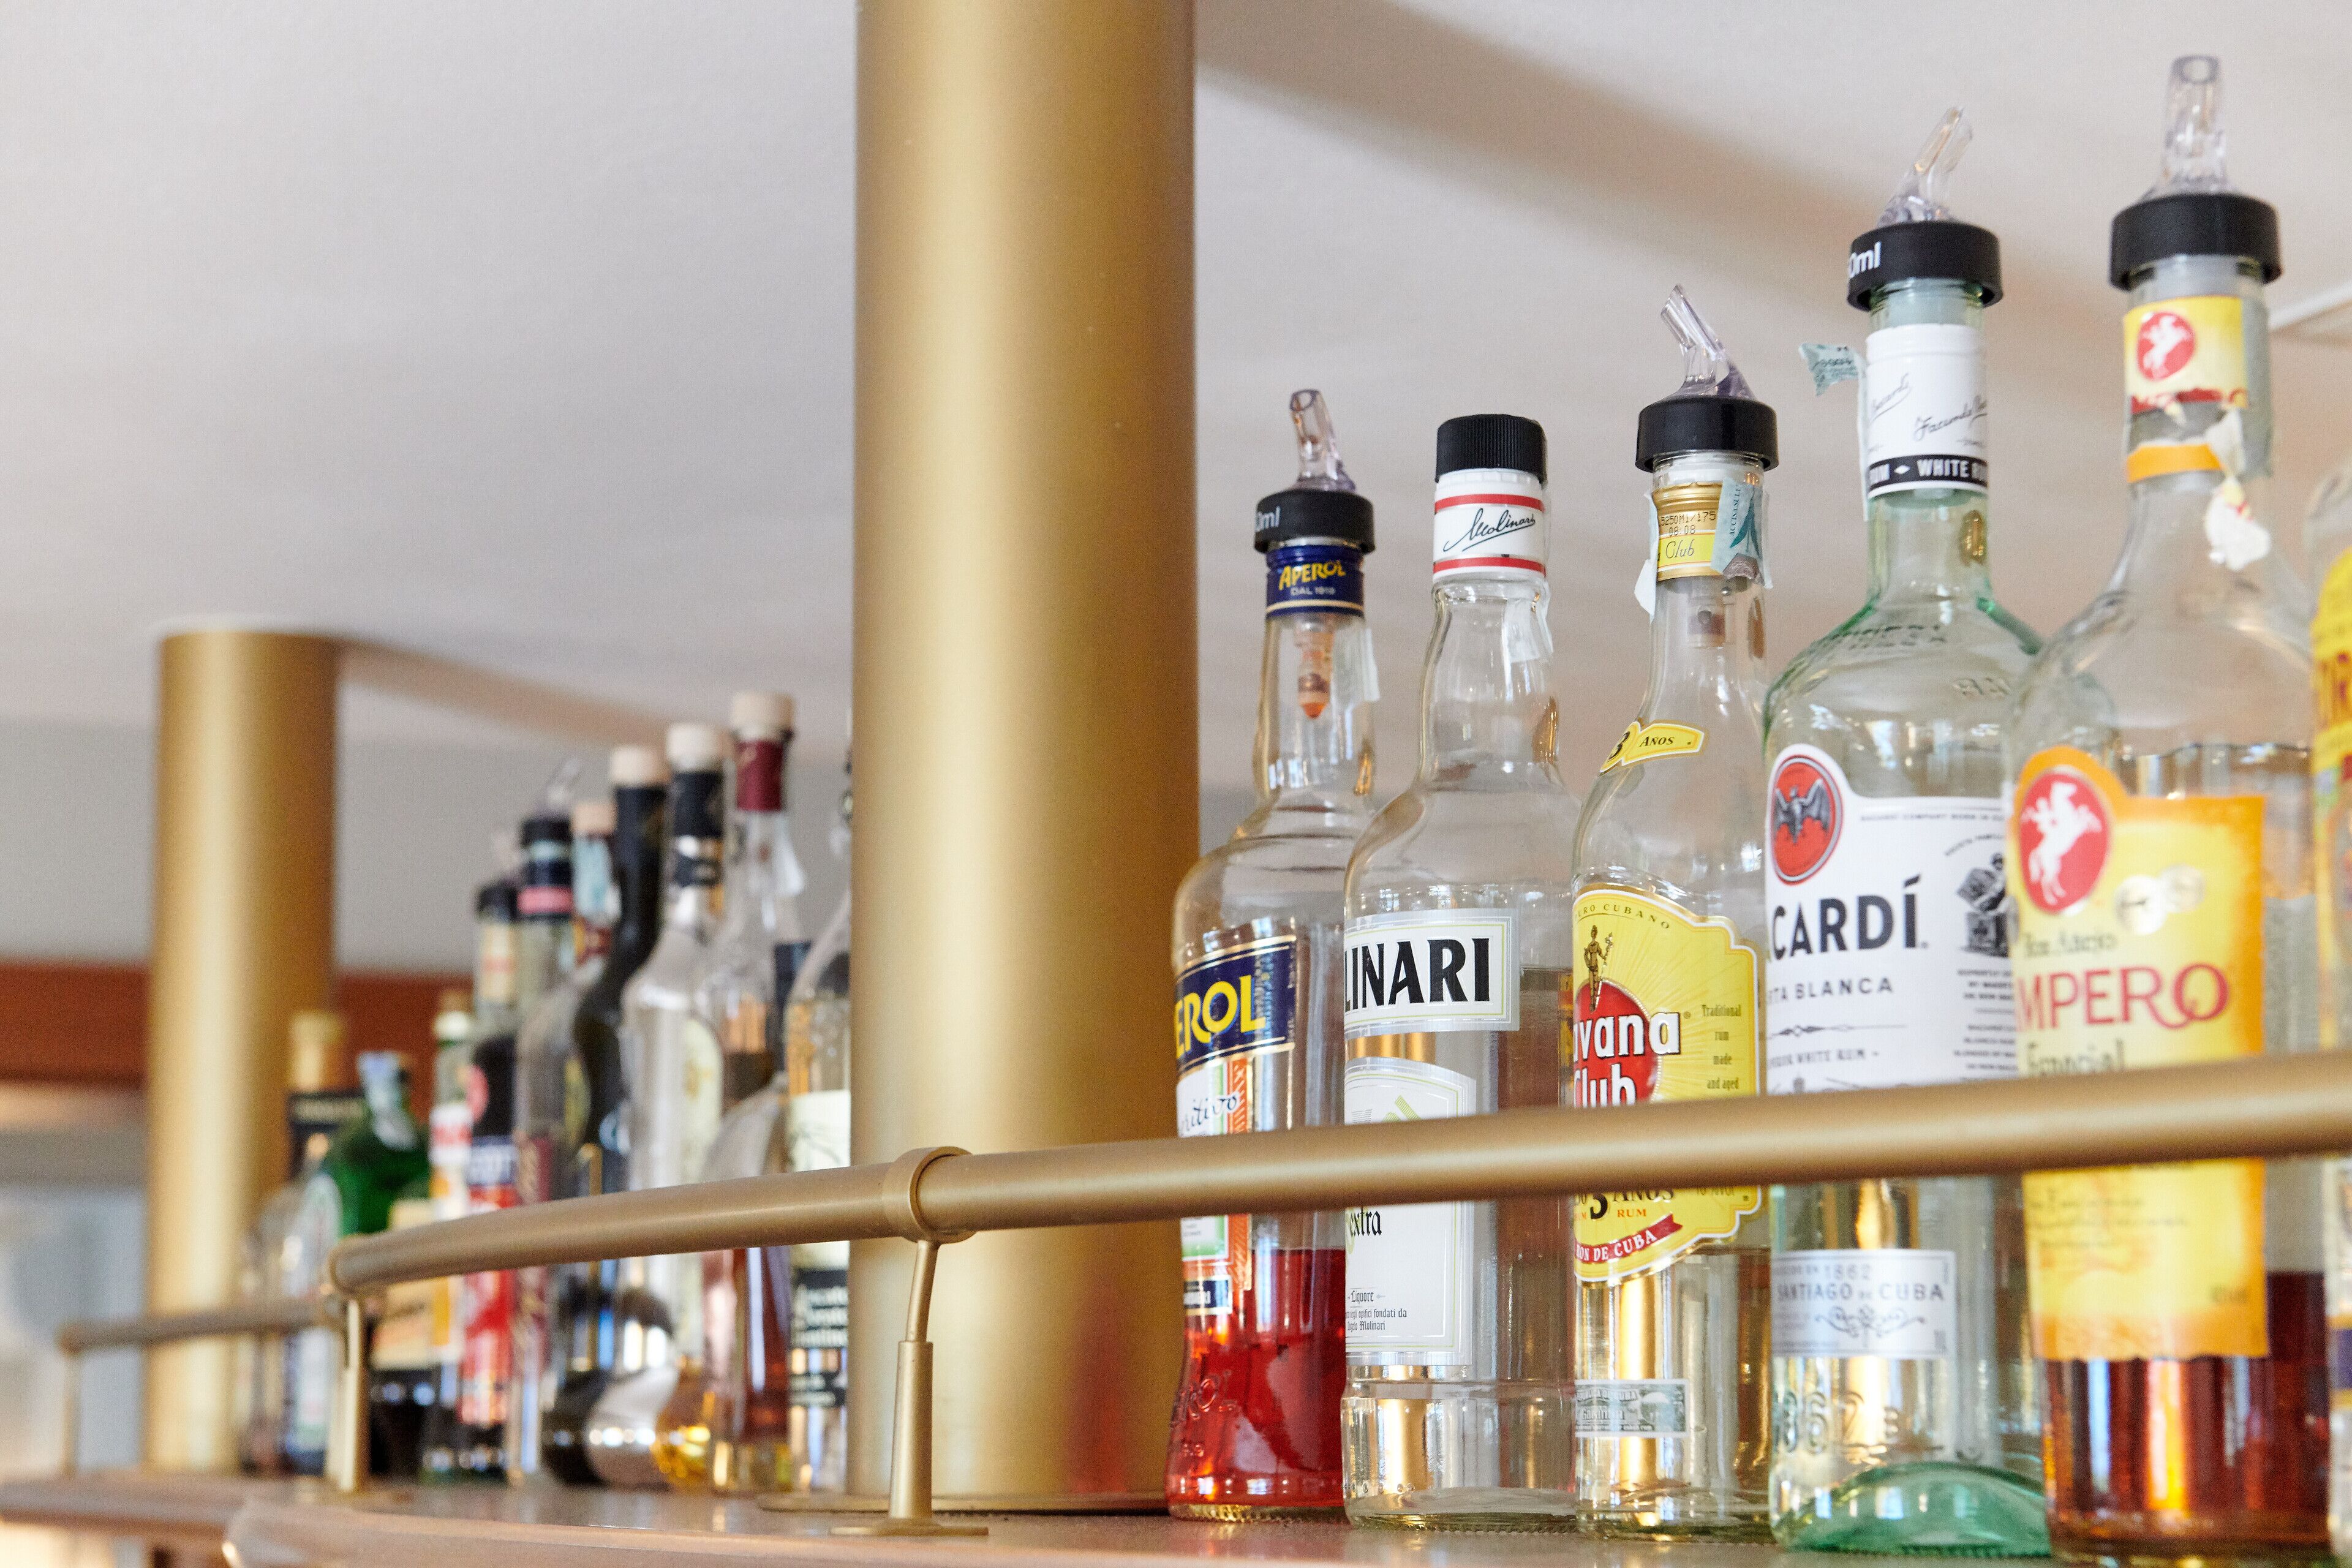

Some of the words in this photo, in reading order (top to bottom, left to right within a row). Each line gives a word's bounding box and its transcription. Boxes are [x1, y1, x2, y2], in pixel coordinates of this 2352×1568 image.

[1917, 459, 1970, 477] WHITE
[1443, 508, 1536, 552] Molinari
[1668, 524, 1696, 537] 08:08
[1665, 539, 1695, 559] Club
[1278, 559, 1346, 590] APEROL
[1638, 736, 1675, 747] AÑOS
[1603, 903, 1670, 929] CUBANO
[1795, 977, 1893, 1000] BLANCA
[2016, 962, 2230, 1032] MPERO
[1175, 974, 1266, 1059] EROL
[1349, 1205, 1382, 1236] extra
[1617, 1208, 1647, 1218] RUM
[1593, 1246, 1609, 1262] DE
[1614, 1229, 1657, 1257] CUBA
[1351, 1290, 1374, 1305] Liquore
[1879, 1283, 1944, 1300] CUBA
[1374, 1308, 1396, 1318] fondati
[1398, 1308, 1407, 1317] da
[1360, 1321, 1385, 1330] Molinari
